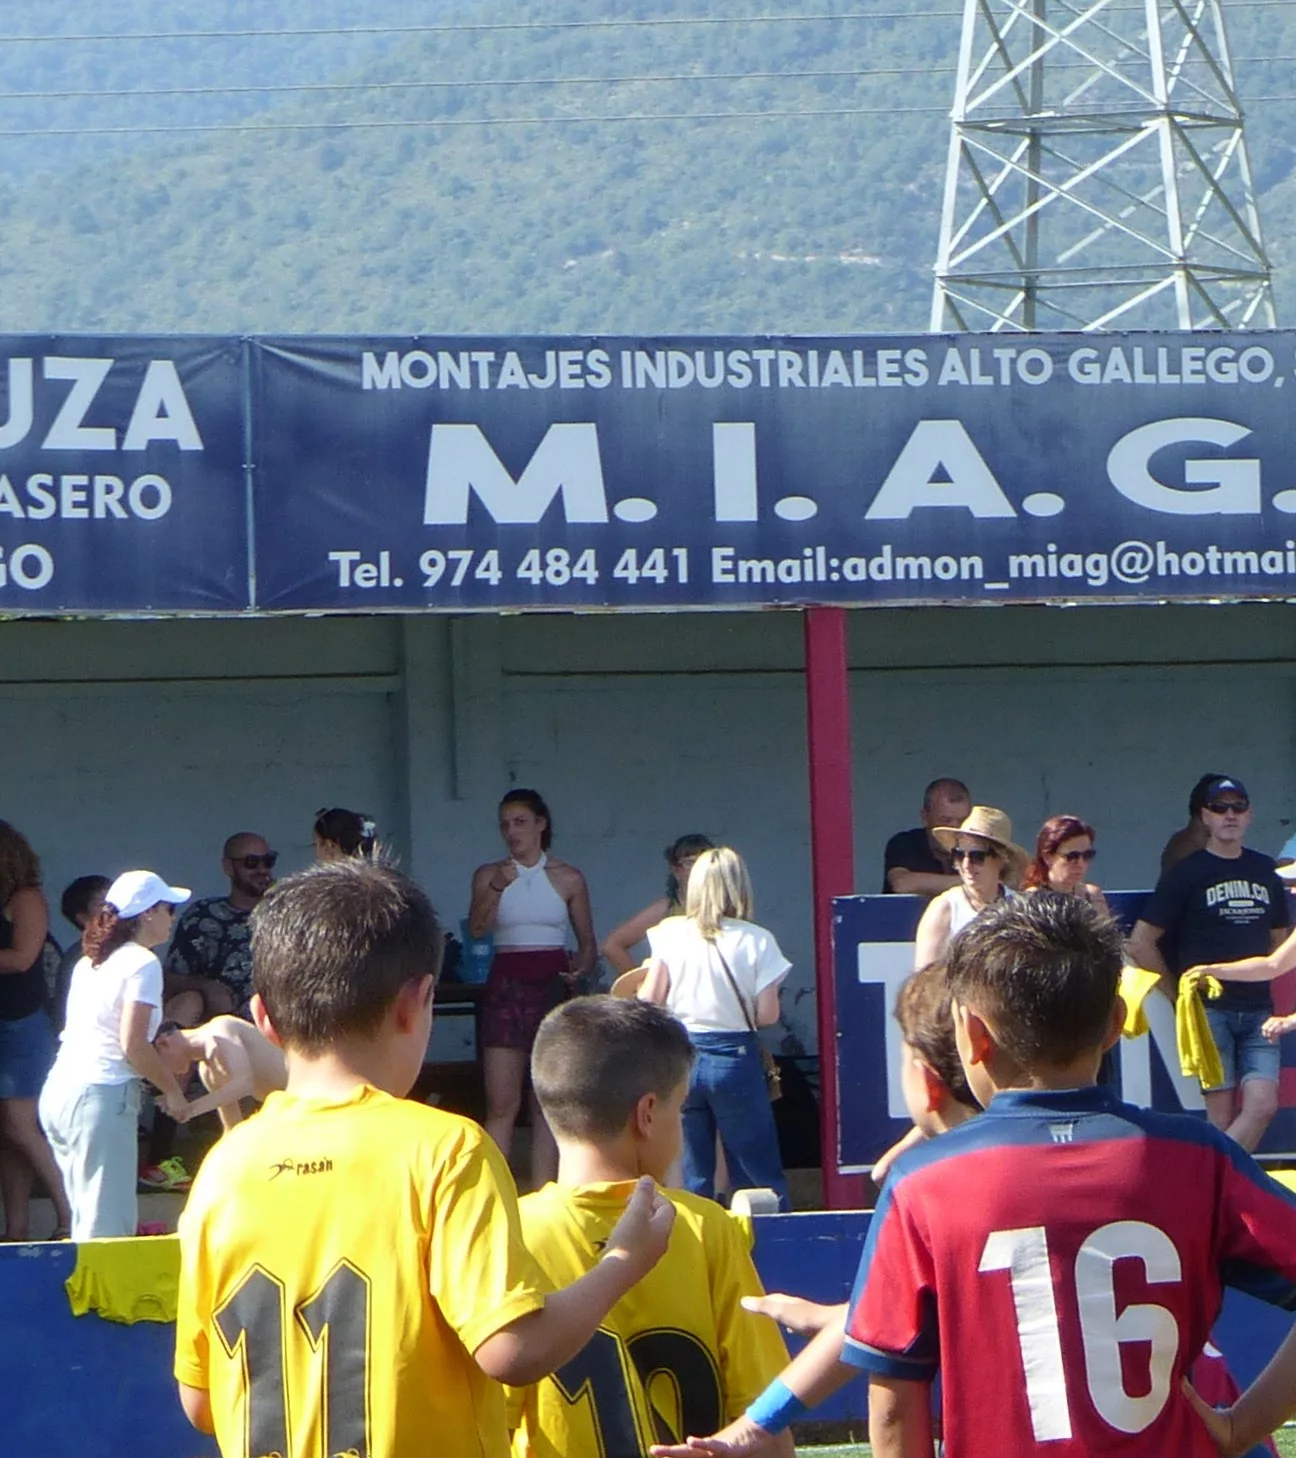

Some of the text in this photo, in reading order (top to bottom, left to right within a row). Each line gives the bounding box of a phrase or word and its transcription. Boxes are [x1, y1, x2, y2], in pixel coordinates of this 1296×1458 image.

[362, 350, 610, 390] MONTAJES
[622, 348, 928, 388] INDUSTRIALES
[937, 347, 1053, 387] ALTO
[1067, 346, 1285, 388] GALLEGO,
[423, 423, 657, 524] M.
[712, 422, 818, 521] I.
[864, 420, 1065, 519] A.
[0, 474, 172, 520] ASERO
[0, 544, 54, 590] O
[329, 550, 403, 588] Tel.
[420, 549, 502, 587] 974
[516, 548, 599, 586] 484
[612, 546, 690, 585] 441
[978, 1220, 1182, 1442] 16
